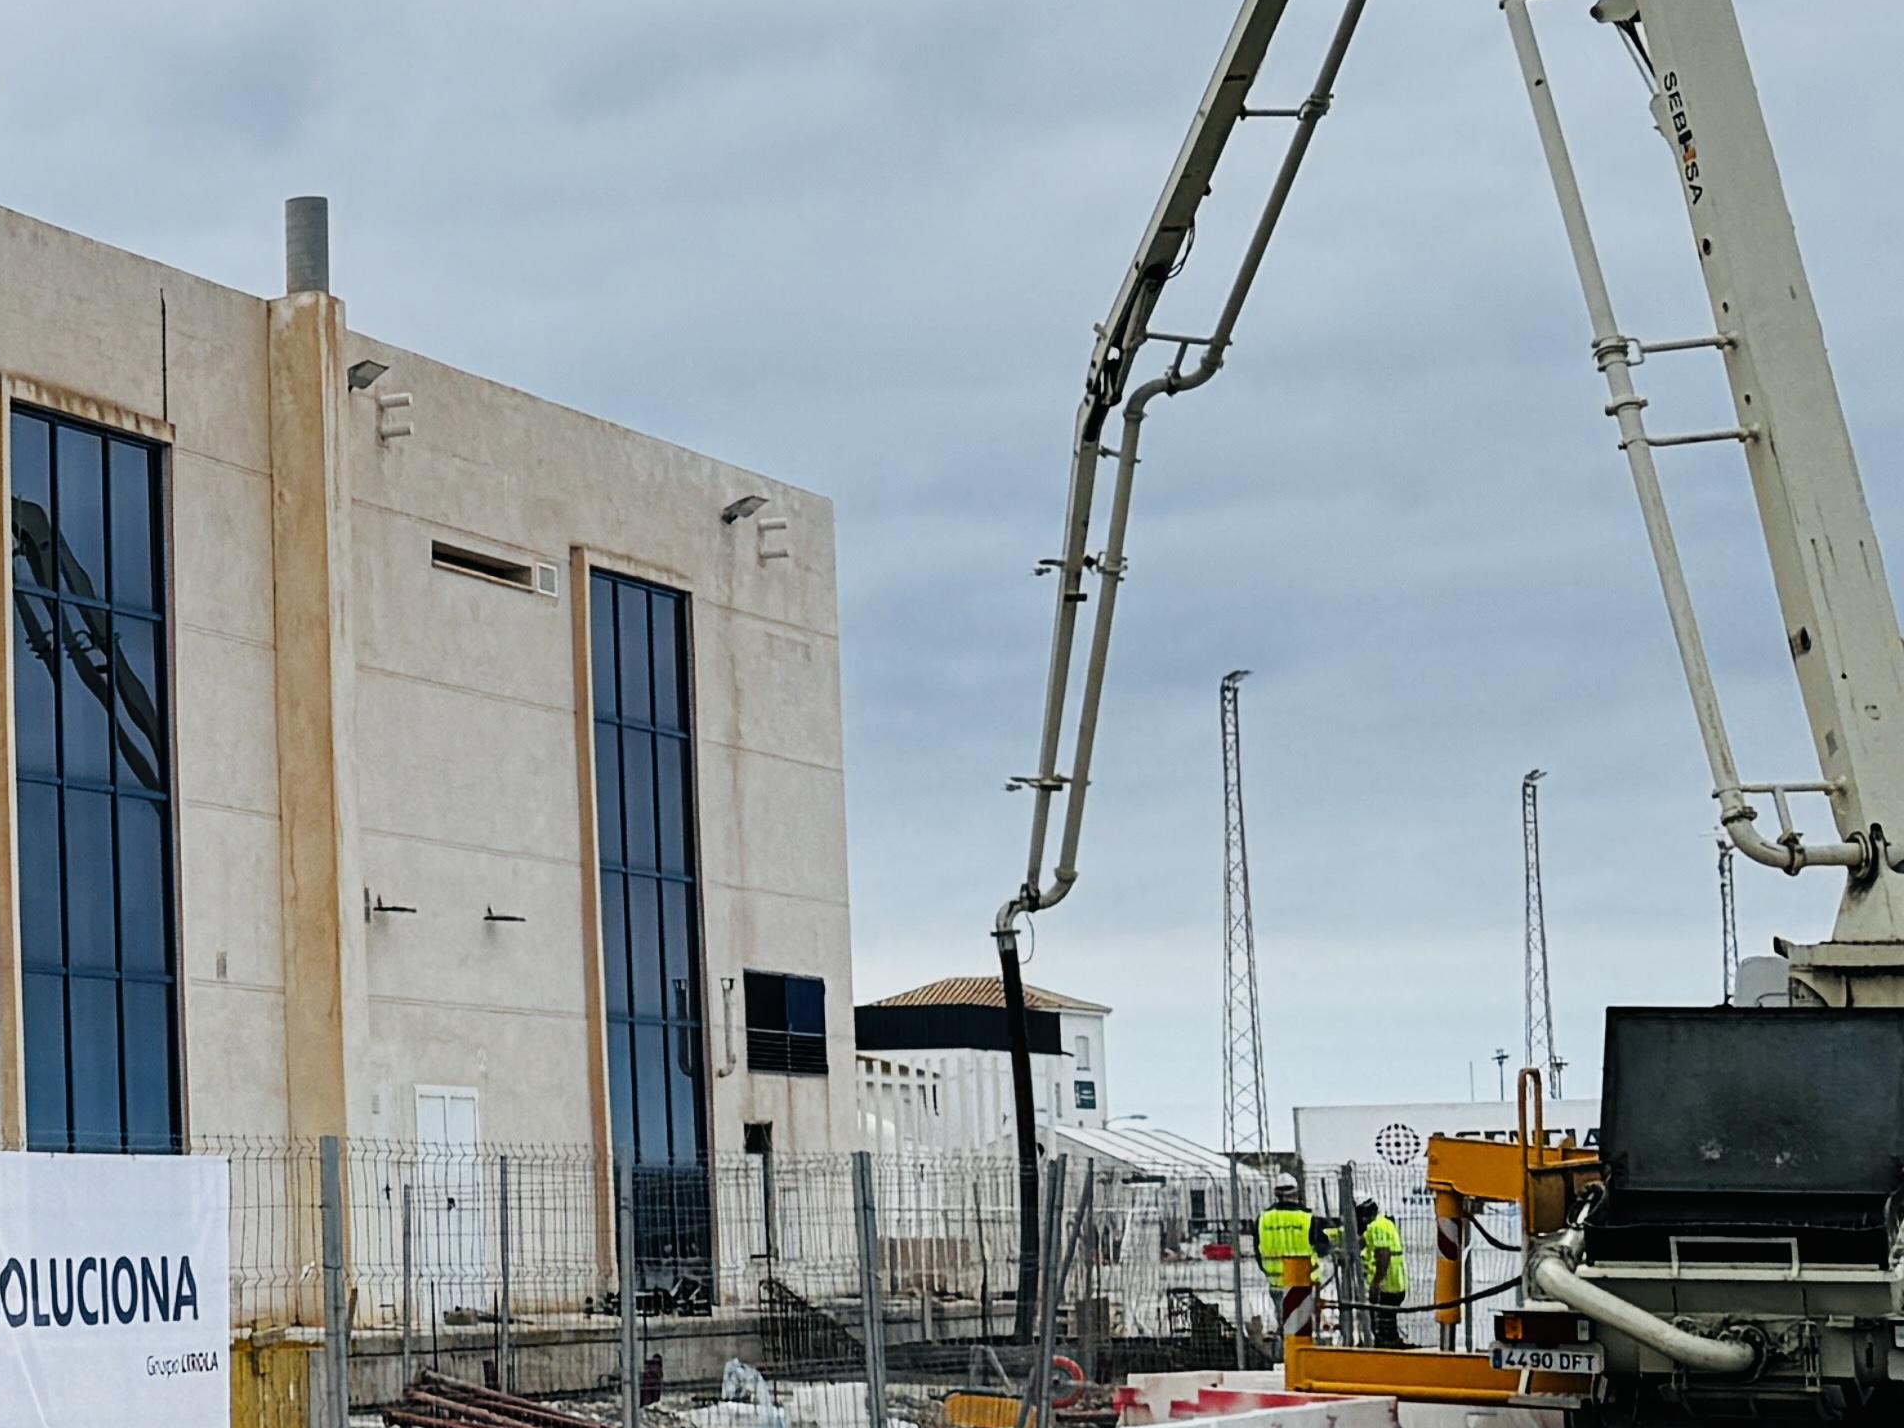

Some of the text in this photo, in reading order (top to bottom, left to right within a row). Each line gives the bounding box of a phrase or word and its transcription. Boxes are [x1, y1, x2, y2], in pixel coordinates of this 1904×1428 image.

[146, 1354, 180, 1379] Grupo
[1504, 1351, 1595, 1371] 4490 DFT
